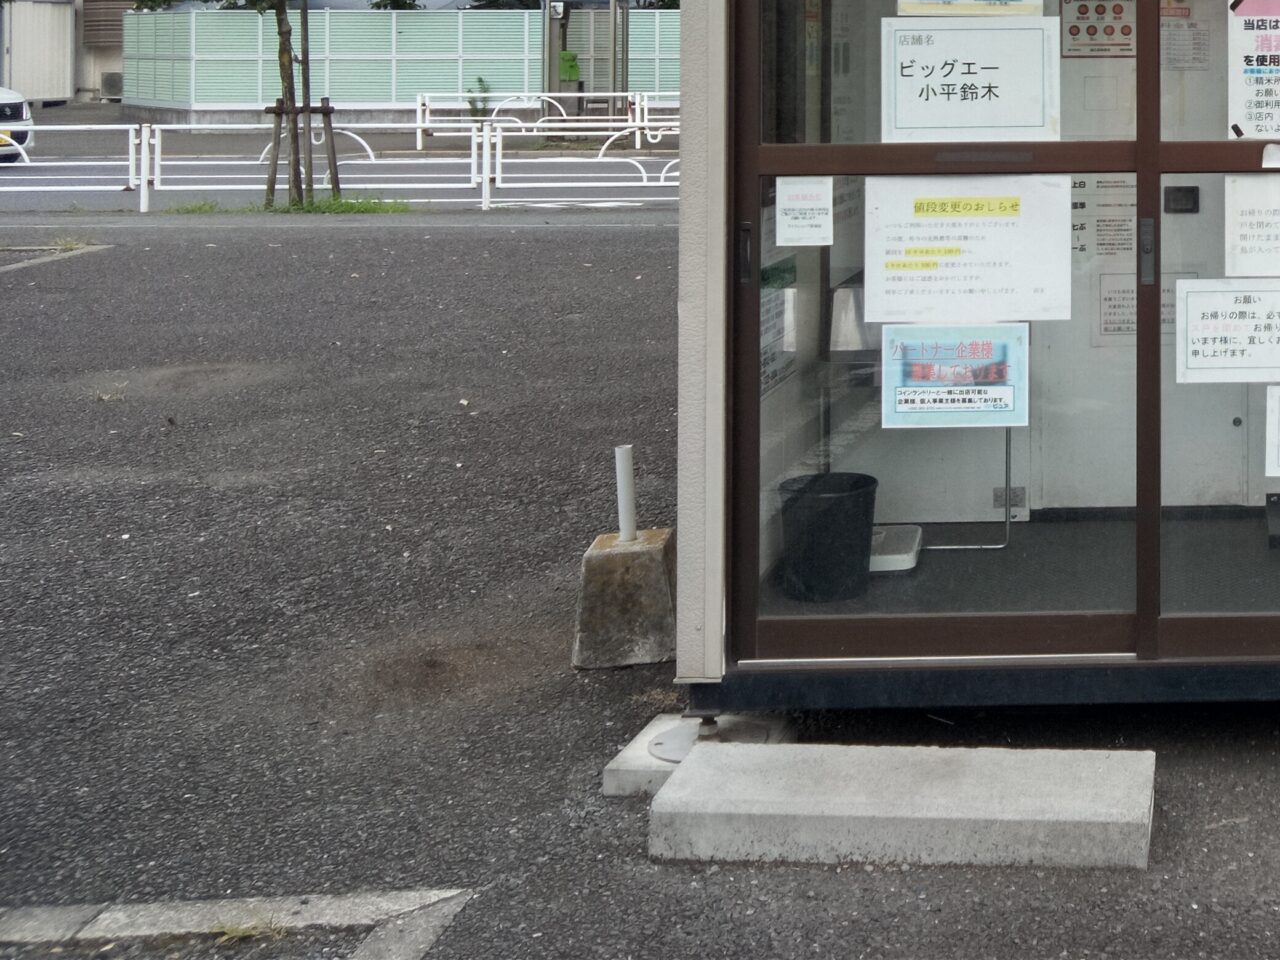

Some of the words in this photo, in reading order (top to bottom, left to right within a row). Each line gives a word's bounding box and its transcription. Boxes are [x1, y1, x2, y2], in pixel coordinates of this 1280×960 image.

[898, 34, 935, 46] 店舗名
[899, 58, 1000, 78] ビッグエー
[918, 82, 1000, 102] 小平鈴木
[914, 200, 1020, 213] 値段変更のおしらせ
[1234, 295, 1262, 305] お願い
[892, 340, 993, 358] パートナー企業様
[1191, 348, 1252, 358] 申し上げます。
